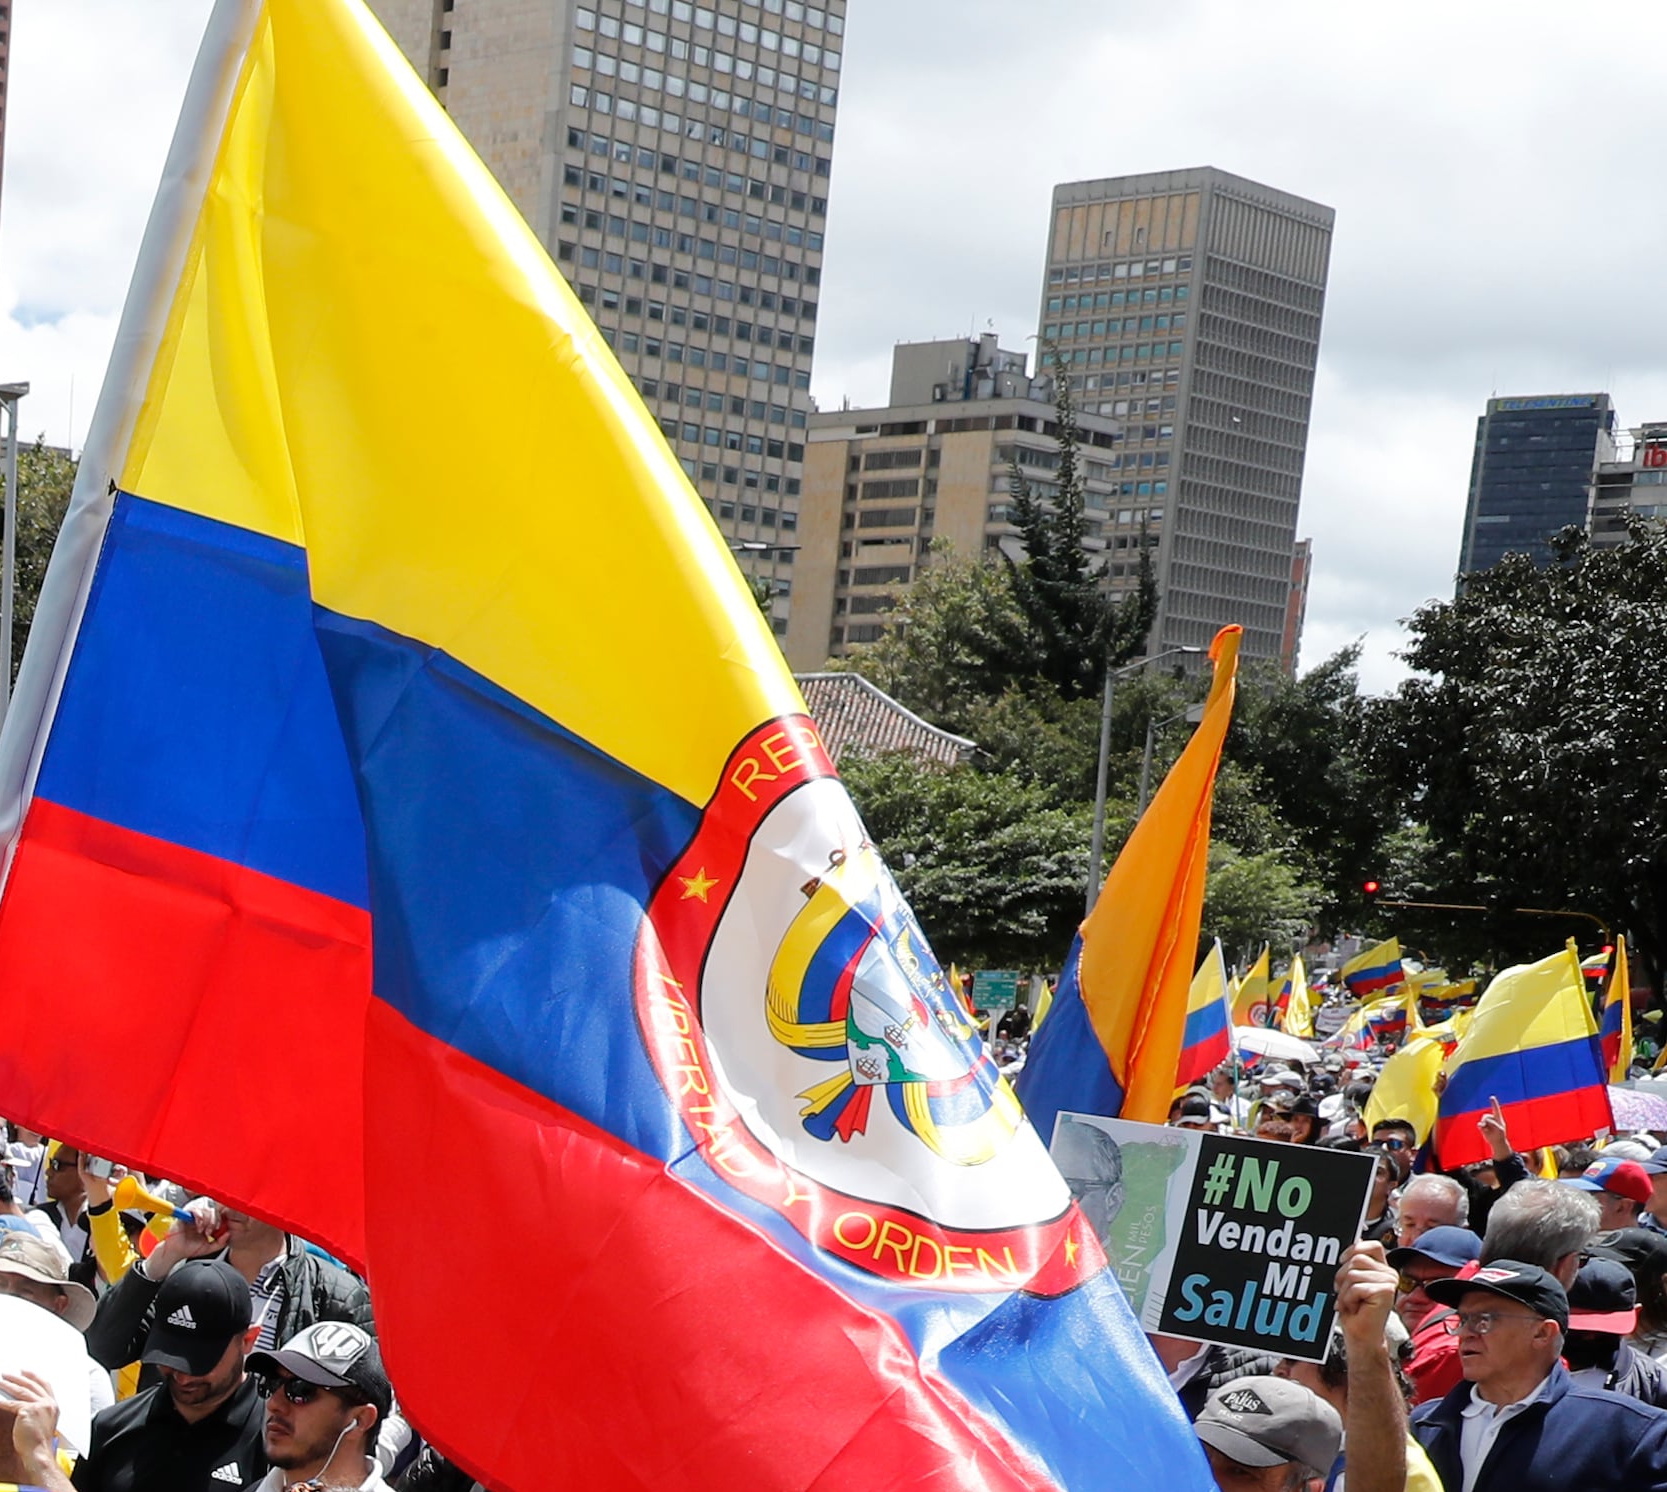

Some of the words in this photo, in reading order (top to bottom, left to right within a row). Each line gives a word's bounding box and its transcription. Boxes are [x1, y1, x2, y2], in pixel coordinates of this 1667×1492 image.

[647, 967, 760, 1180] LIBERTAD
[833, 1211, 1021, 1279] ORDEN
[1199, 1152, 1314, 1219] #No
[1131, 1219, 1143, 1244] MIL
[1139, 1204, 1157, 1246] PESOS
[1197, 1208, 1341, 1266] Vendan
[1125, 1242, 1148, 1300] IEN
[1262, 1260, 1313, 1301] Mi
[167, 1316, 198, 1330] adidas
[1173, 1272, 1329, 1343] Salud
[211, 1470, 243, 1486] adidas
